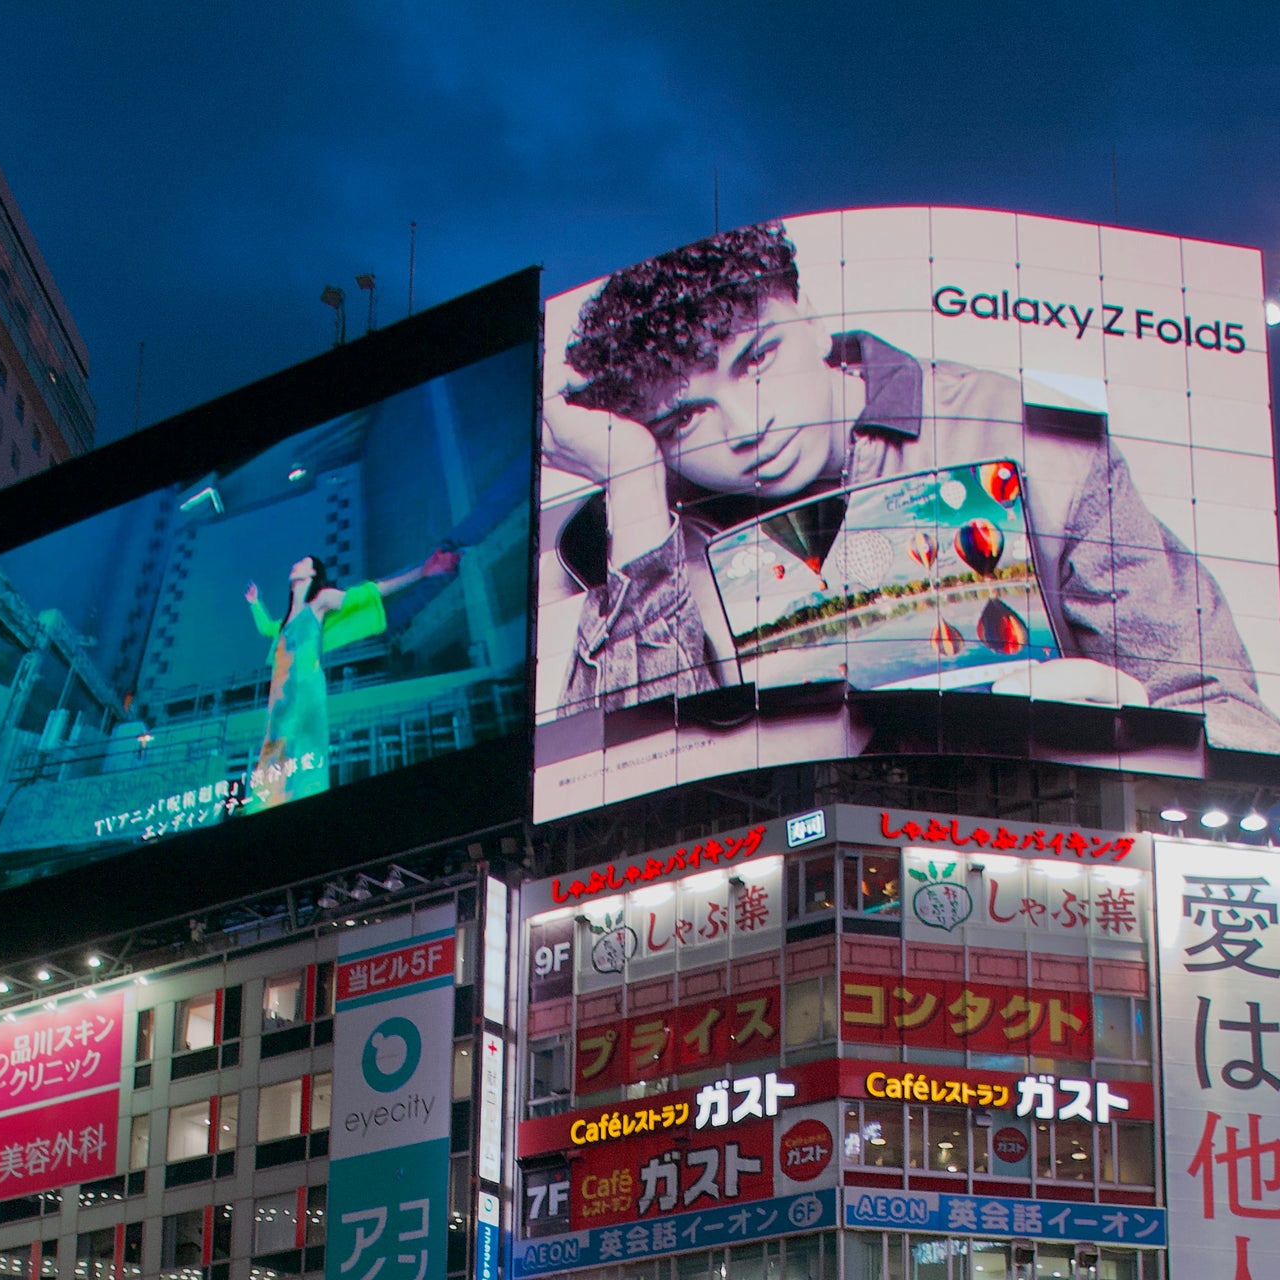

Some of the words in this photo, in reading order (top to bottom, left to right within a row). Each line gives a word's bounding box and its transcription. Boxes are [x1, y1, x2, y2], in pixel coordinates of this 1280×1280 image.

[933, 285, 1092, 339] Galaxy
[1101, 305, 1126, 337] Z
[1135, 310, 1246, 355] Fold5
[881, 812, 1136, 861] しゃぶしゃぶバイキング
[552, 825, 767, 903] しゃぶしゃぶバイキング
[647, 885, 770, 952] しゃぶ葉
[989, 879, 1137, 935] しゃぶ葉
[347, 952, 444, 992] 当ビル5F
[534, 941, 570, 977] 9F
[577, 997, 775, 1079] プライス
[842, 983, 1083, 1044] コンタクト
[9, 1014, 116, 1065] 品川スキン
[8, 1049, 101, 1096] クリニック
[343, 1094, 436, 1138] eyecity
[694, 1072, 796, 1130] ガスト
[1016, 1074, 1129, 1124] ガスト
[637, 1144, 762, 1216] ガスト
[786, 1144, 828, 1167] ガスト
[526, 1181, 569, 1220] 7F
[581, 1167, 633, 1200] Café
[581, 1195, 632, 1217] レストラン
[523, 1239, 580, 1269] AEON
[599, 1205, 779, 1261] 英会話イーオン
[792, 1200, 817, 1220] 6F
[856, 1196, 929, 1222] AEON
[948, 1199, 1160, 1239] 英会話イーオン
